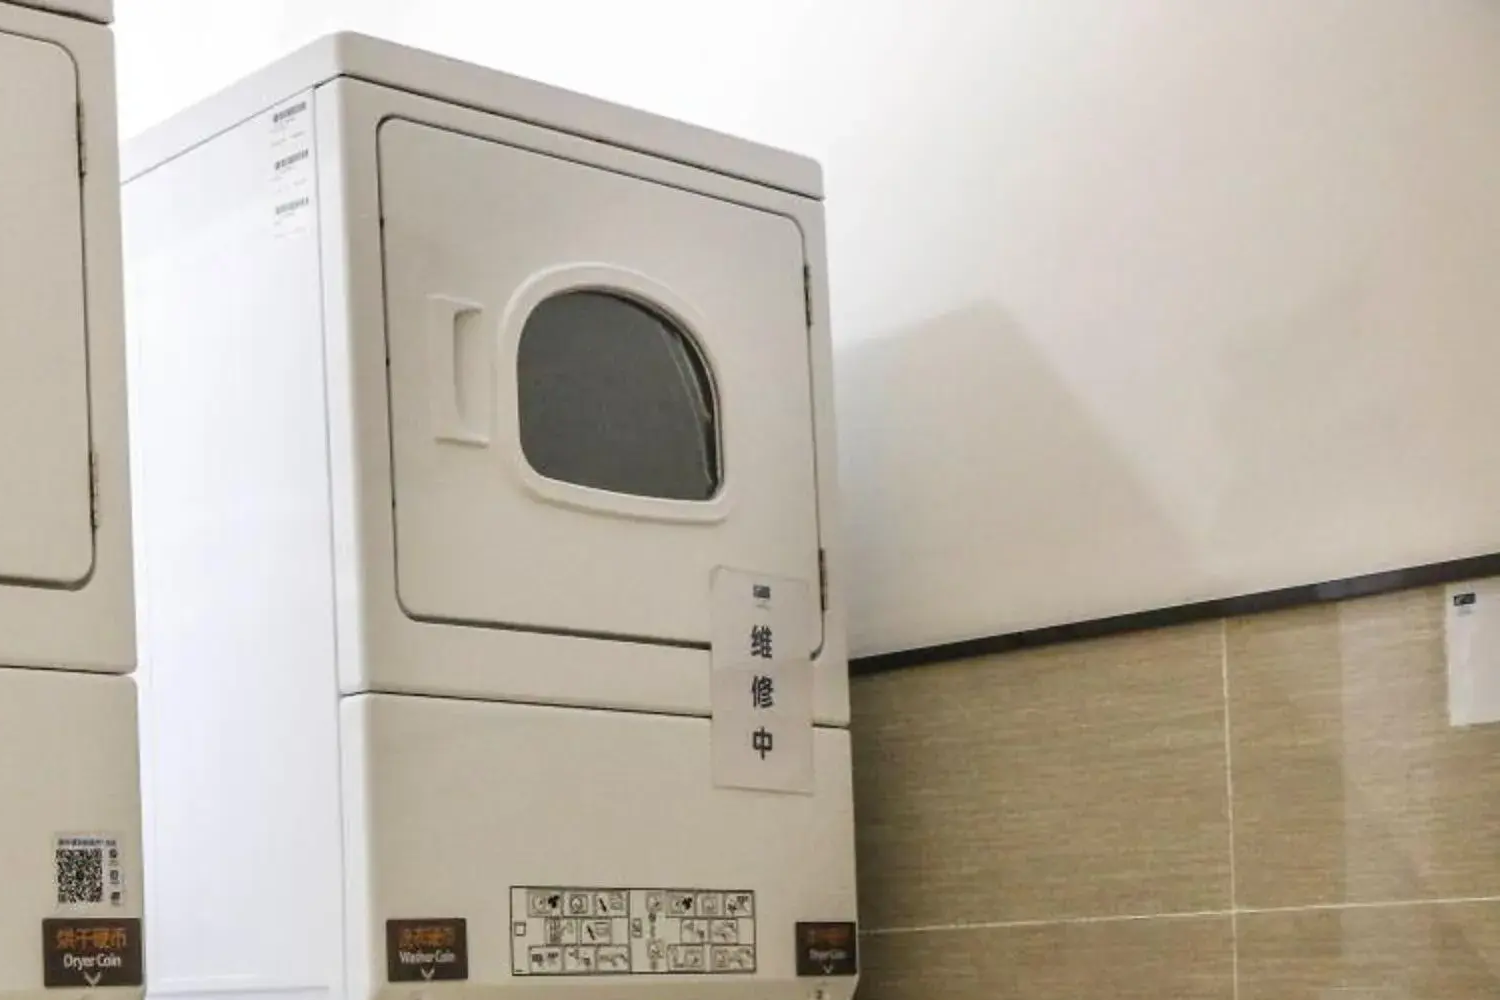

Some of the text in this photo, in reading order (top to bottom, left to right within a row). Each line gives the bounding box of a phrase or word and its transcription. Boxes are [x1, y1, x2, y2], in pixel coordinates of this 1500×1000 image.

[750, 624, 774, 760] 维修中
[63, 953, 122, 971] Dryer Coin
